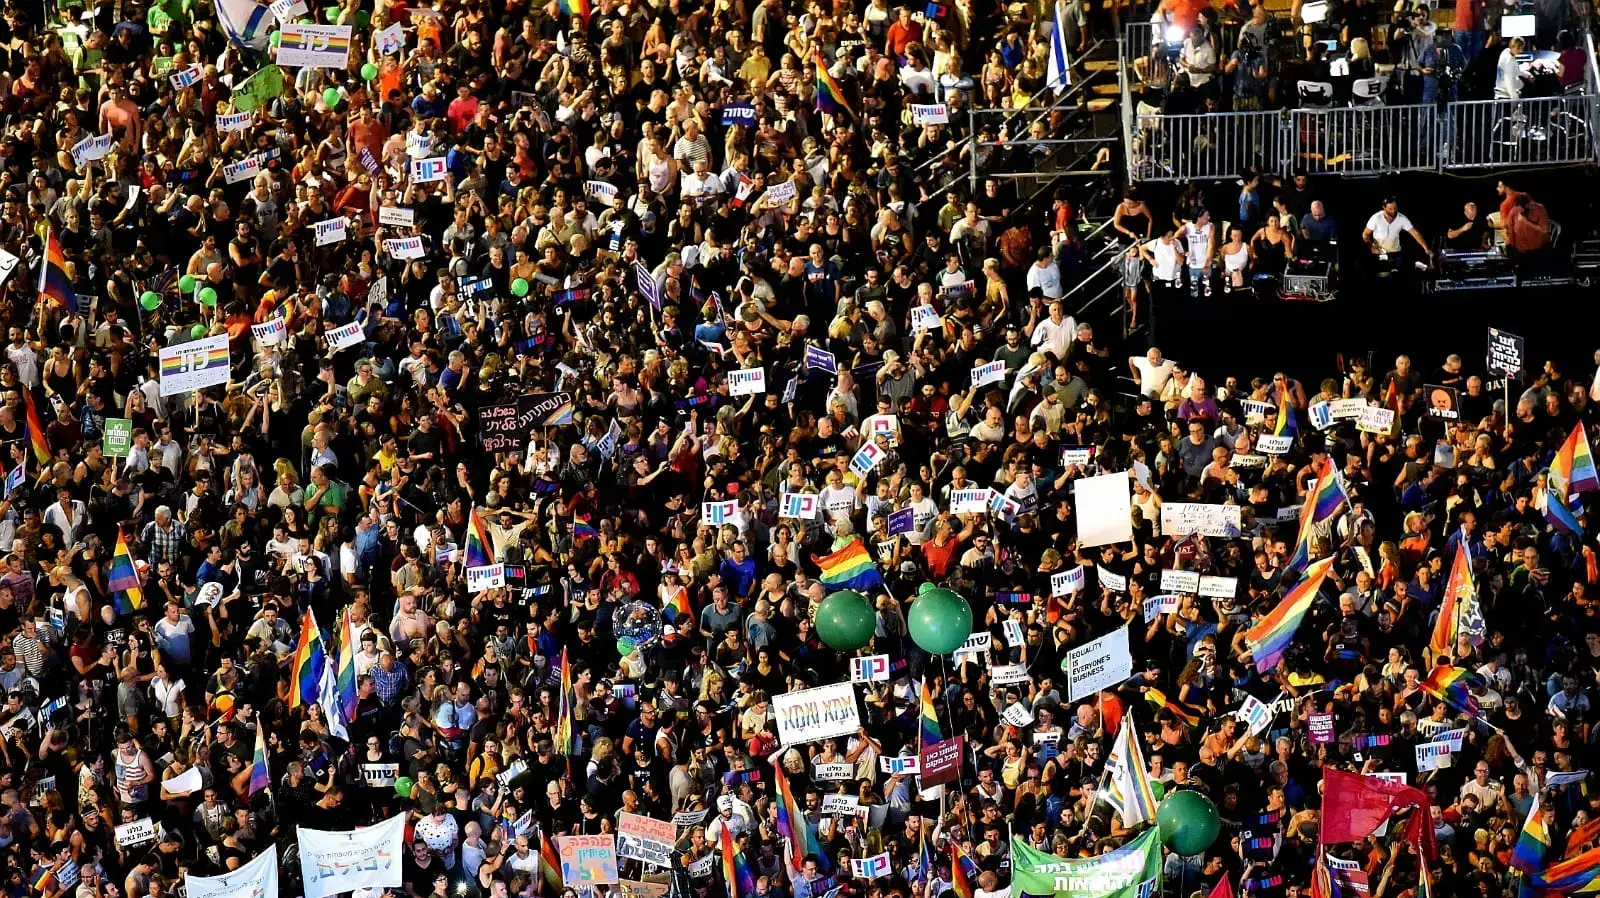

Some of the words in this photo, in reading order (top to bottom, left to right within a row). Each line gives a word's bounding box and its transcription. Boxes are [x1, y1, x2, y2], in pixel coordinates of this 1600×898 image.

[1072, 641, 1102, 660] EQUALITY
[1073, 660, 1079, 668] IS
[1073, 655, 1111, 676] EVERYONE'S
[1073, 666, 1104, 684] BUSINESS
[127, 826, 143, 834] כולנו
